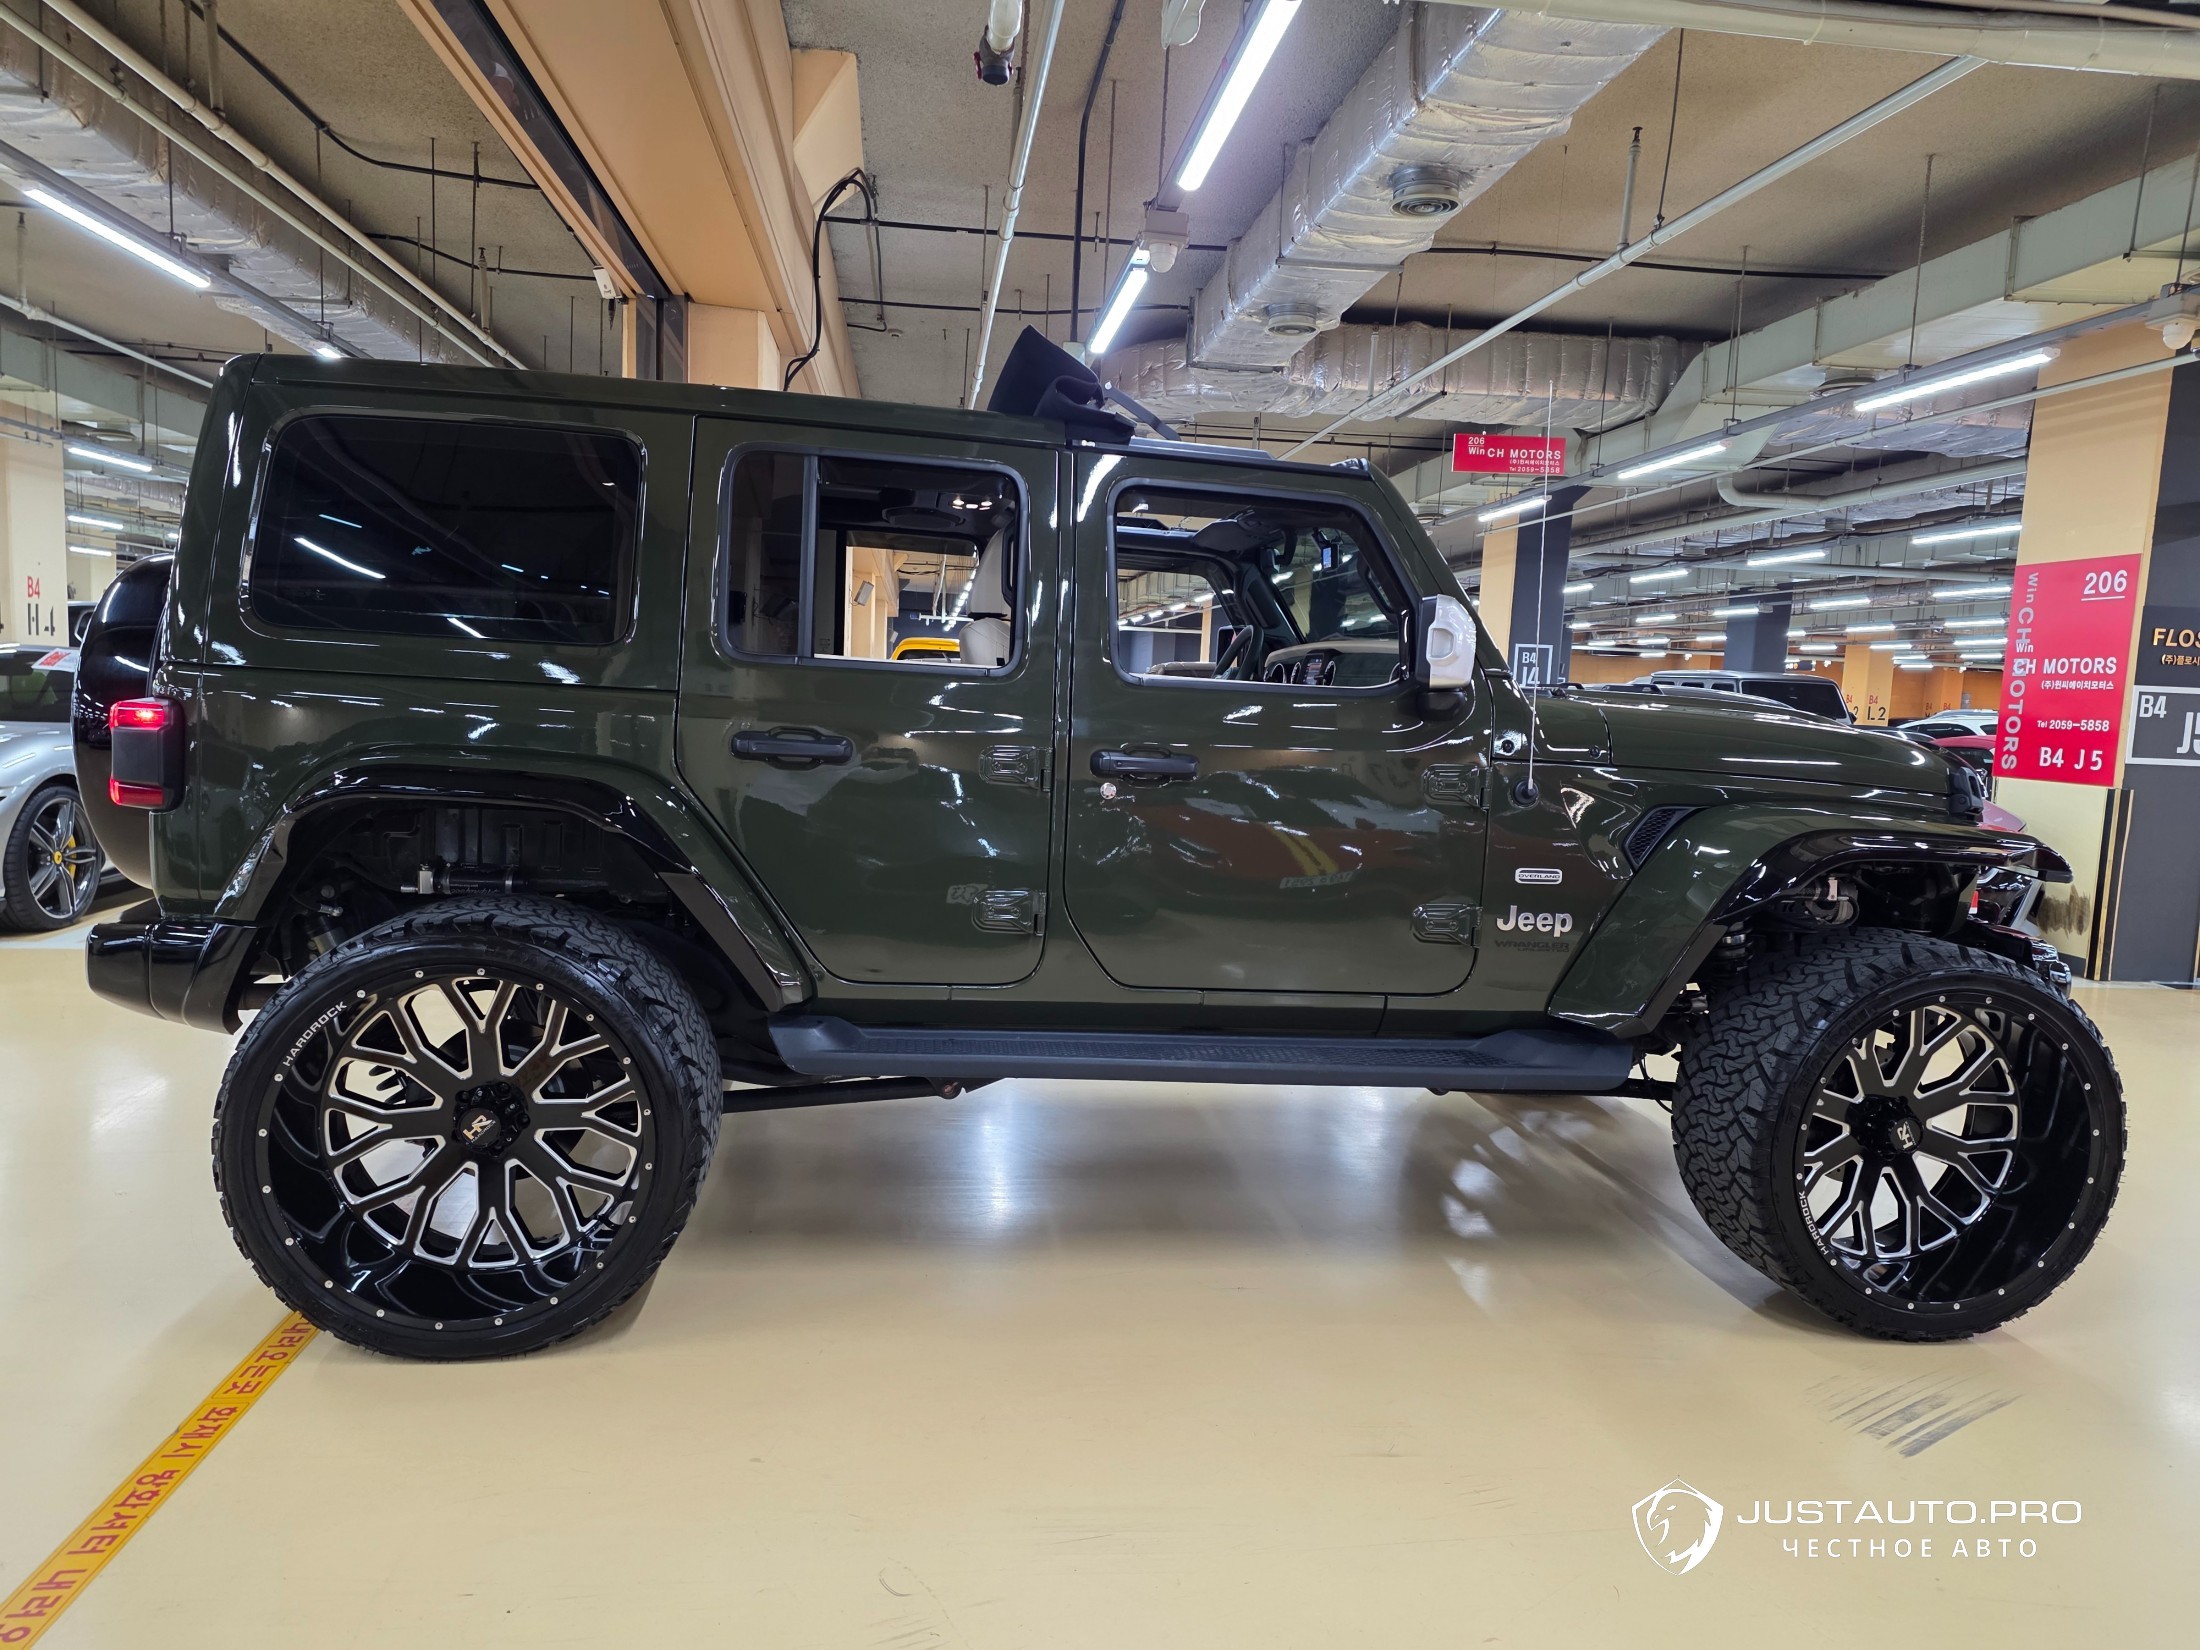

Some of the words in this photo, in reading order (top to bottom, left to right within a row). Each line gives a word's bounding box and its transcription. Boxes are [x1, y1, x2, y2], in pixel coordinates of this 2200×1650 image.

[1468, 436, 1485, 445] 206
[1468, 446, 1485, 455] Win
[1487, 448, 1504, 458] CH
[1510, 448, 1561, 460] MOTORS
[27, 576, 41, 598] B4
[2025, 572, 2040, 603] Win
[2083, 570, 2128, 595] 206
[1522, 652, 1537, 664] B4
[2015, 642, 2034, 653] Win
[2013, 658, 2037, 675] CH
[2043, 657, 2117, 674] MOTORS
[1519, 667, 1540, 688] J4
[1869, 695, 1878, 704] B4
[2139, 695, 2167, 719] B4
[2037, 720, 2048, 728] Tel
[2049, 720, 2110, 732] 2059-5858
[2039, 747, 2064, 768] B4
[1496, 904, 1573, 937] Jeep
[1495, 940, 1570, 950] WRANGLER
[282, 1000, 348, 1067] HARDROCK
[1798, 1190, 1831, 1256] HARDROCK
[161, 1406, 239, 1458] 화재시
